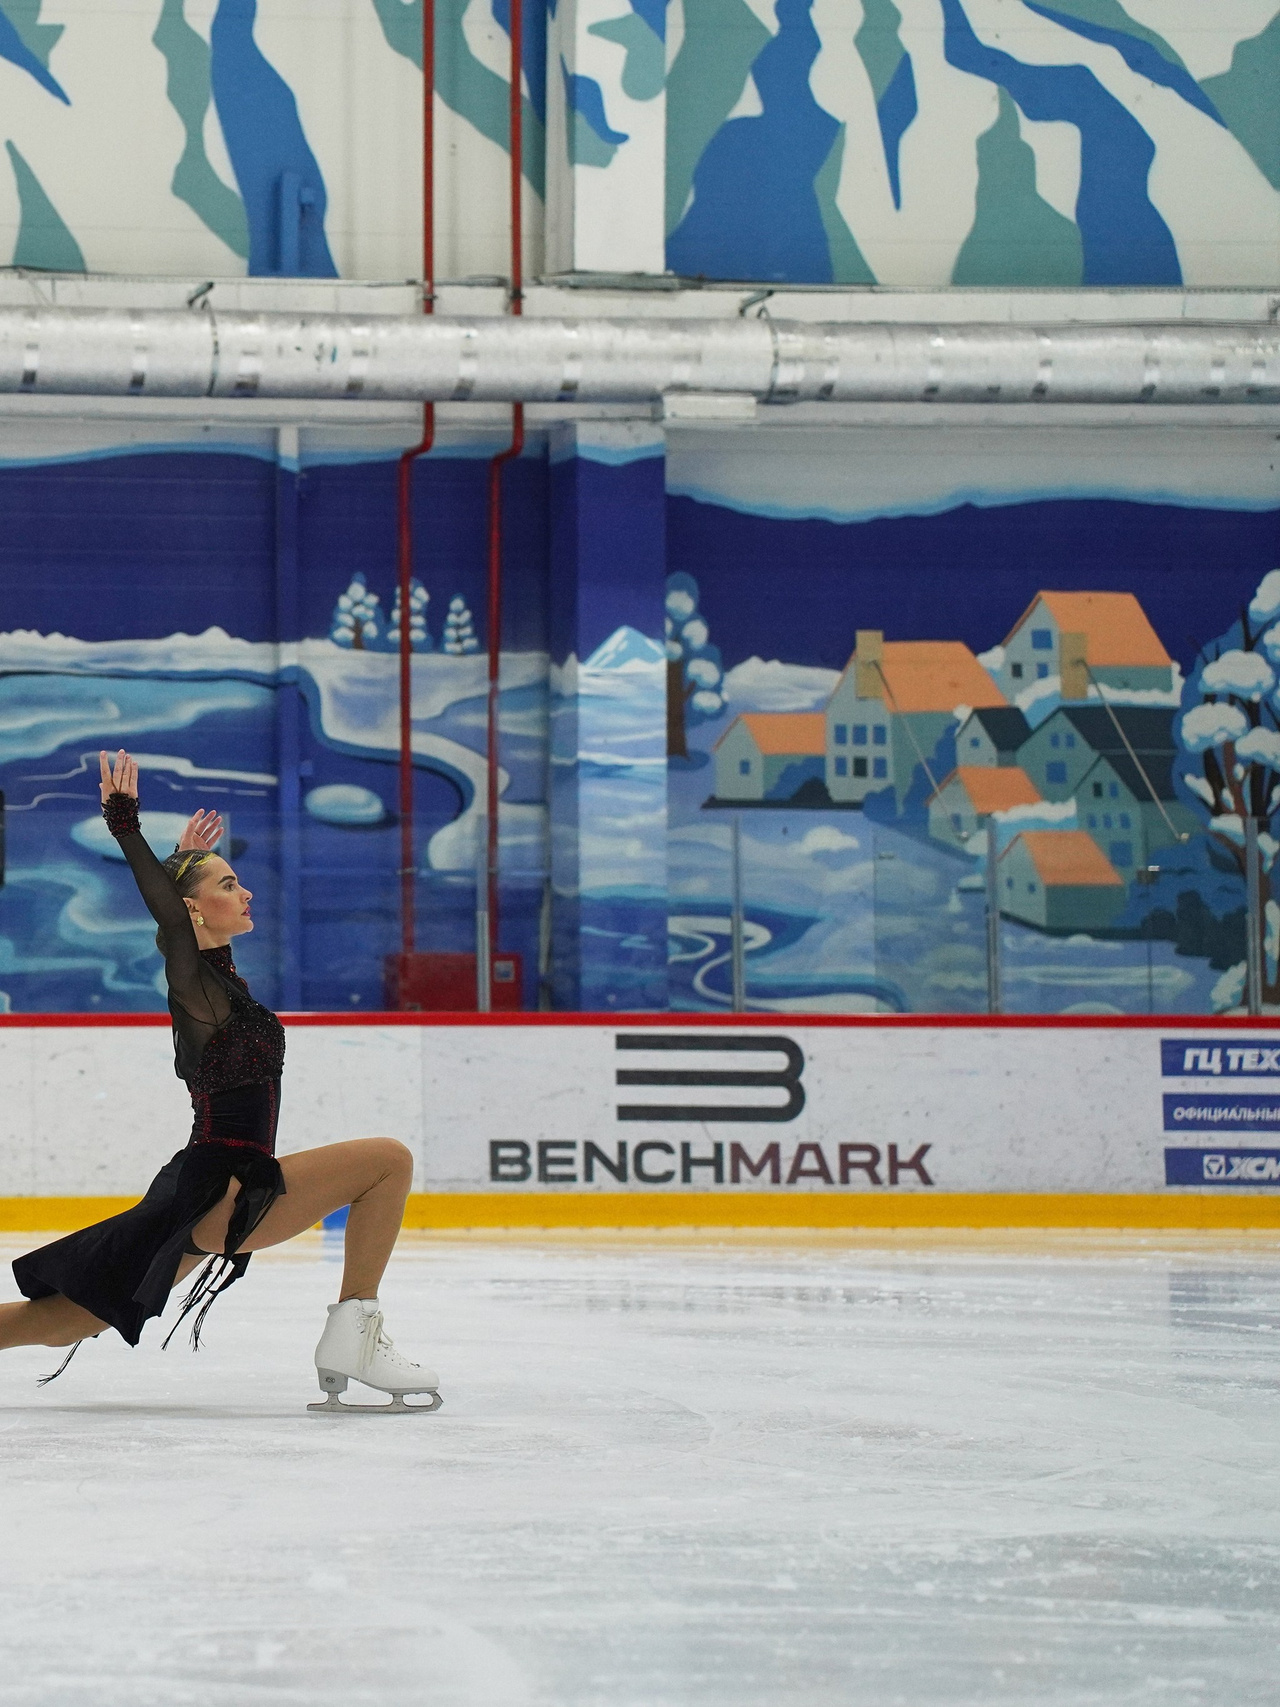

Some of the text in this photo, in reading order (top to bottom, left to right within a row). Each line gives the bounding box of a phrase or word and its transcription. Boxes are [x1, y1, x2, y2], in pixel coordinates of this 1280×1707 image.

[1183, 1047, 1280, 1075] ГЦ ТЕХ
[1173, 1106, 1280, 1123] ОФИЦИАЛЬНЫ
[488, 1139, 934, 1186] BENCHMARK
